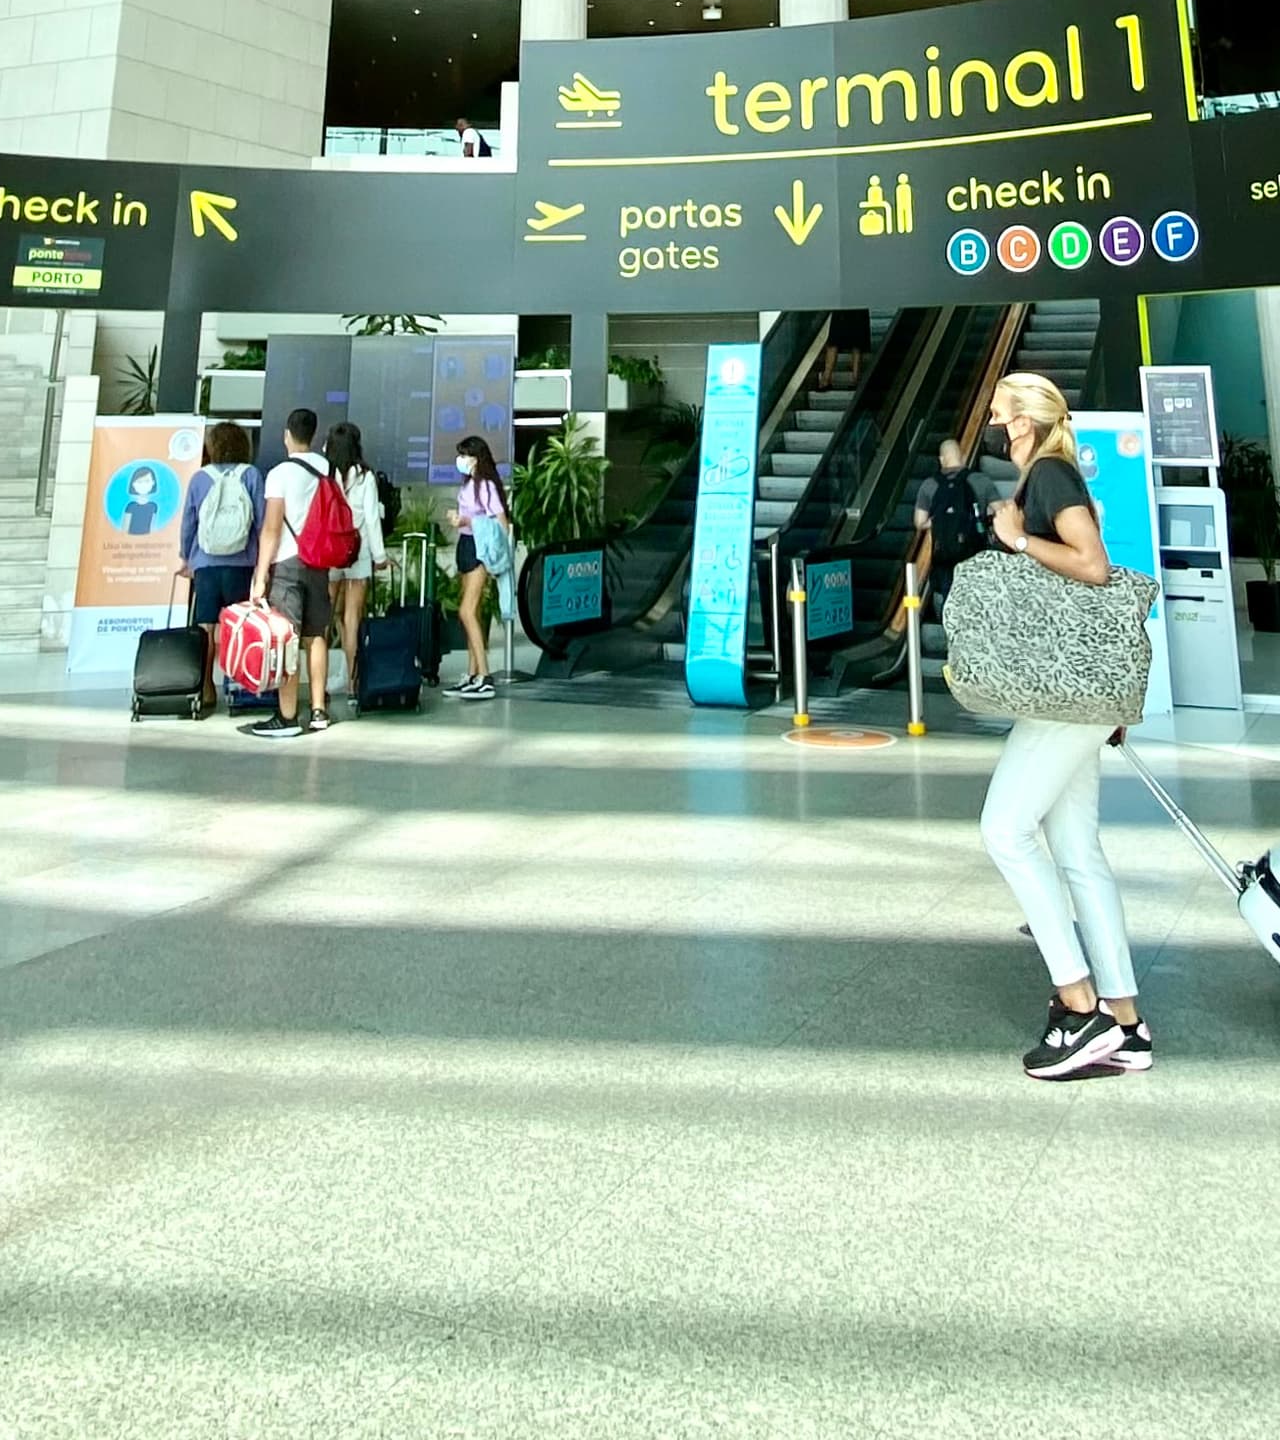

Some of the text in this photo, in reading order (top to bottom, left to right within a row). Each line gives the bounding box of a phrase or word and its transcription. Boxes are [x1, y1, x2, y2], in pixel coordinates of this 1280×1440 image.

[705, 14, 1145, 136] terminal 1
[946, 165, 1111, 212] check in
[112, 192, 147, 227] in
[620, 198, 742, 239] portas
[618, 242, 720, 279] gates
[960, 222, 1183, 265] B C D E F
[31, 271, 84, 285] PORTO
